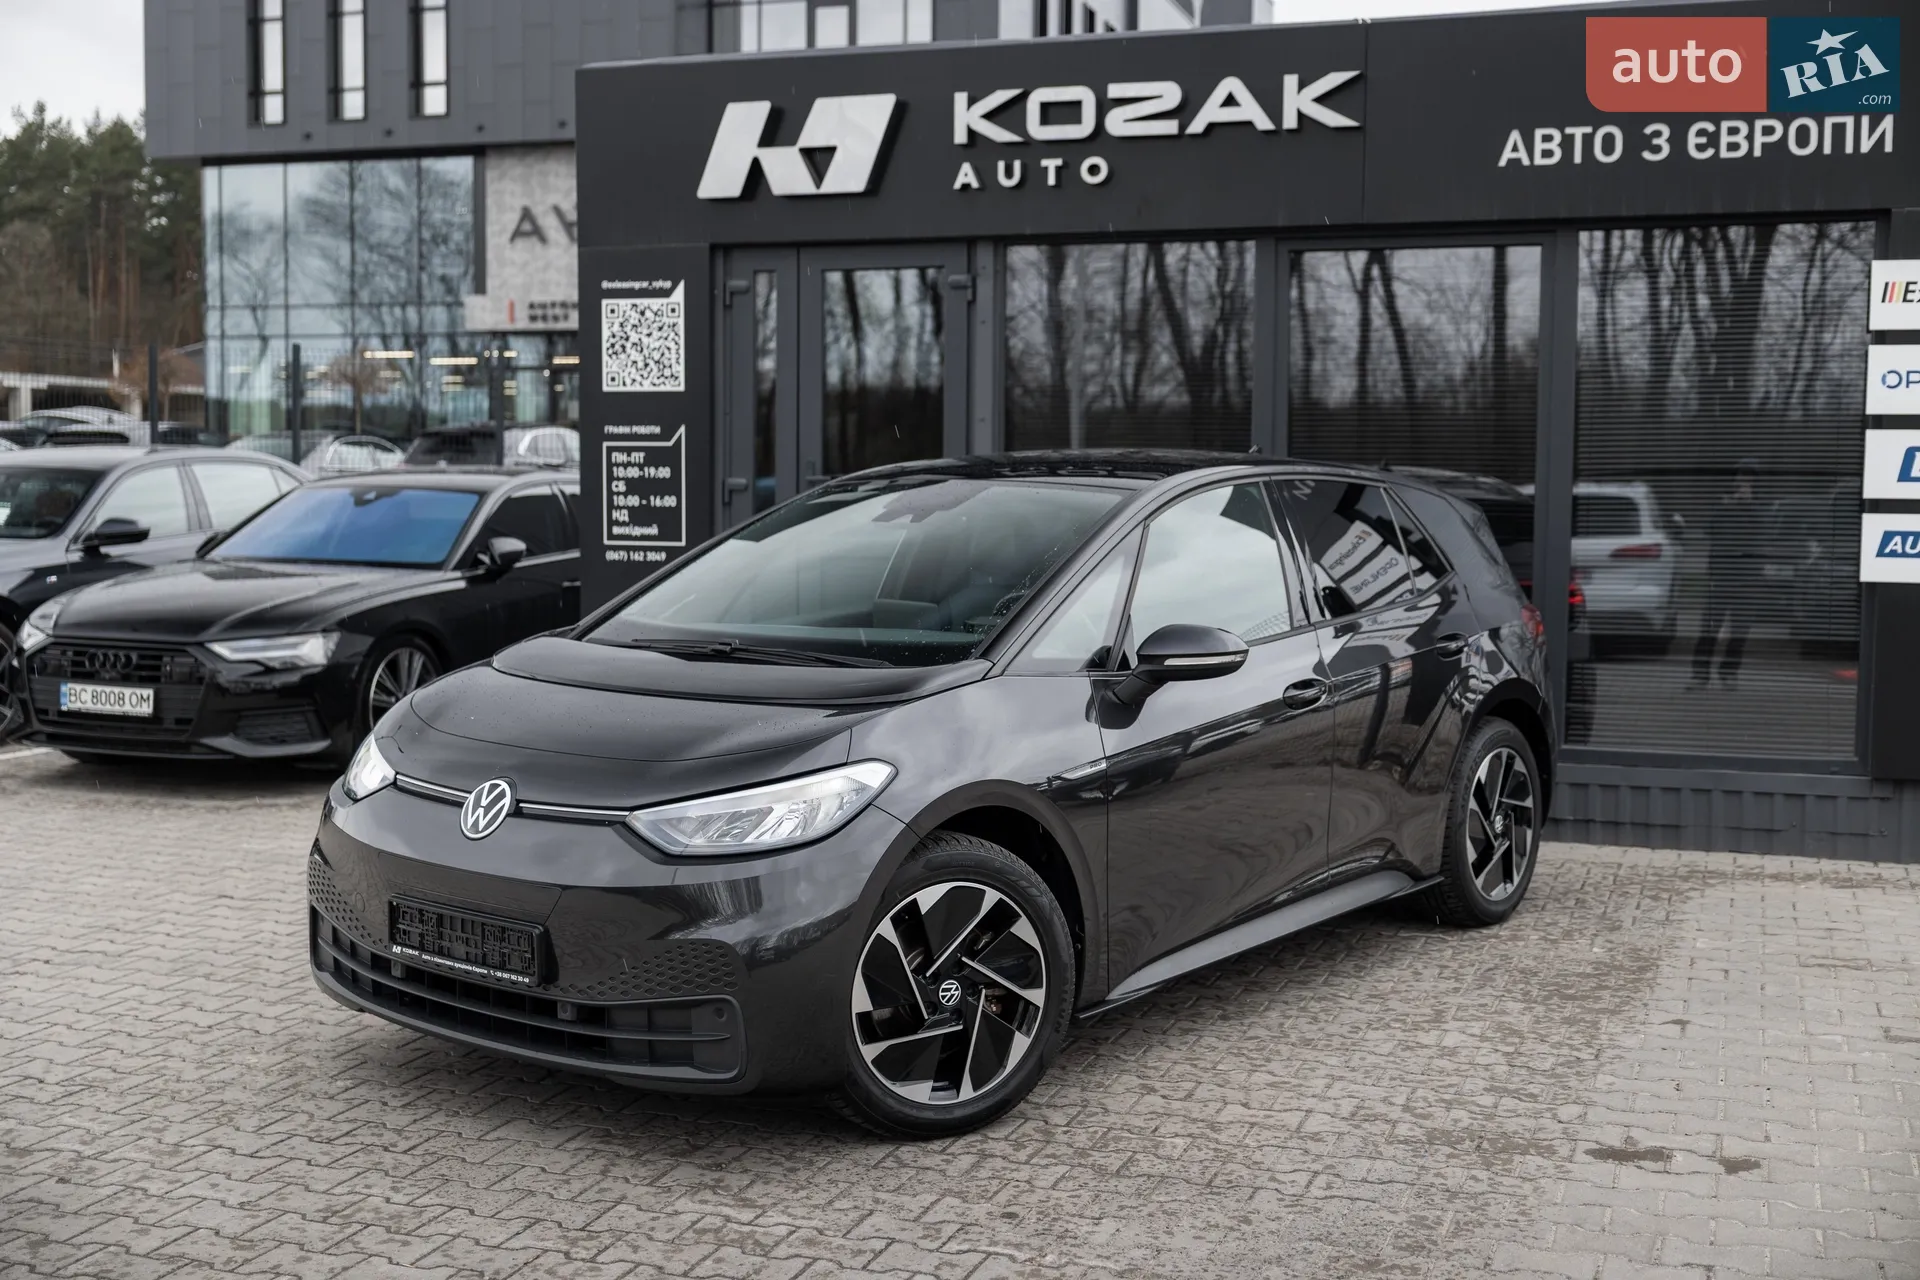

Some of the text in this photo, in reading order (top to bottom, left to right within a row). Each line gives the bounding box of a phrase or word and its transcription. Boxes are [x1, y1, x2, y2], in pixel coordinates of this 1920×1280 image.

[953, 70, 1363, 145] KOZAK
[1497, 113, 1895, 167] АВТО З ЄВРОПИ
[952, 155, 1110, 190] AUTO
[611, 451, 646, 464] ПН-ПТ
[612, 466, 671, 479] 10:00-19:00
[611, 480, 627, 493] СБ
[612, 494, 640, 508] 10:00
[649, 494, 677, 508] 16:00
[611, 508, 630, 523] НД
[629, 549, 645, 562] 162
[68, 687, 151, 709] BC 8008 OM
